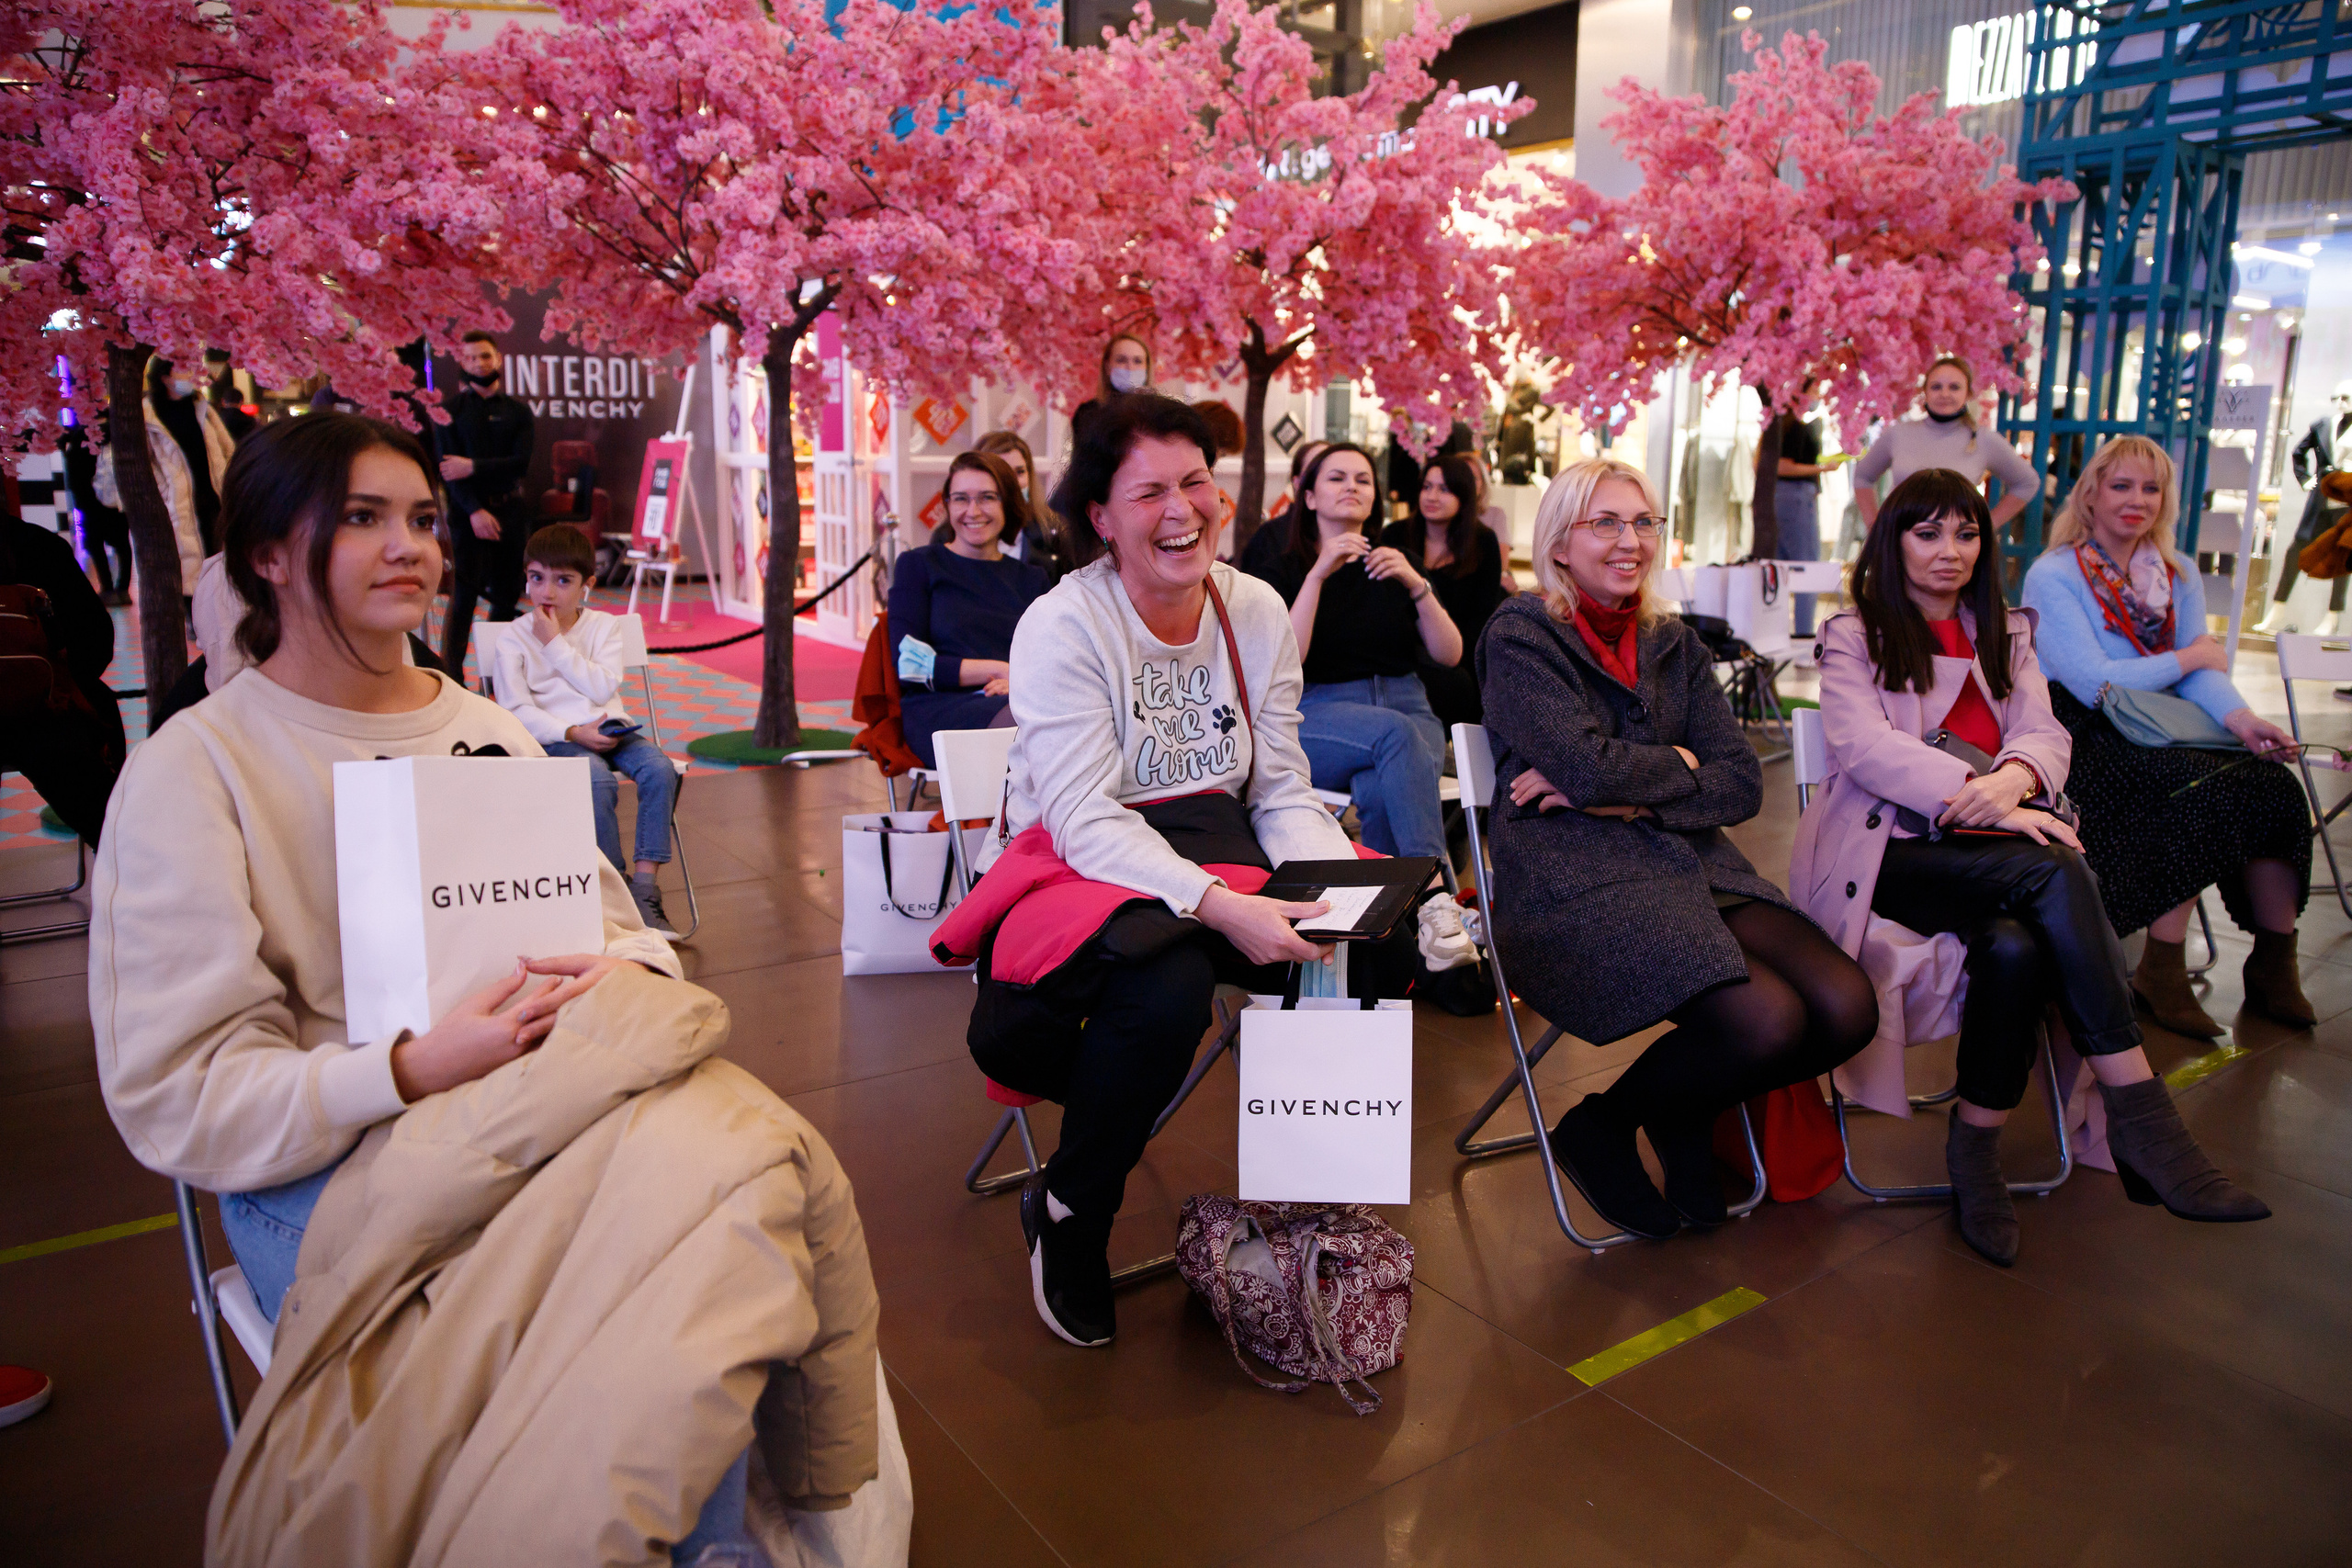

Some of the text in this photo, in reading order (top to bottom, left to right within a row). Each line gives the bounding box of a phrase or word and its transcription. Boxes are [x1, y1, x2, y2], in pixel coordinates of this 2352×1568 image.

[527, 399, 644, 419] VENCHY
[1133, 659, 1212, 710] take
[1152, 708, 1205, 748] me
[431, 874, 592, 908] GIVENCHY
[1247, 1099, 1403, 1116] GIVENCHY
